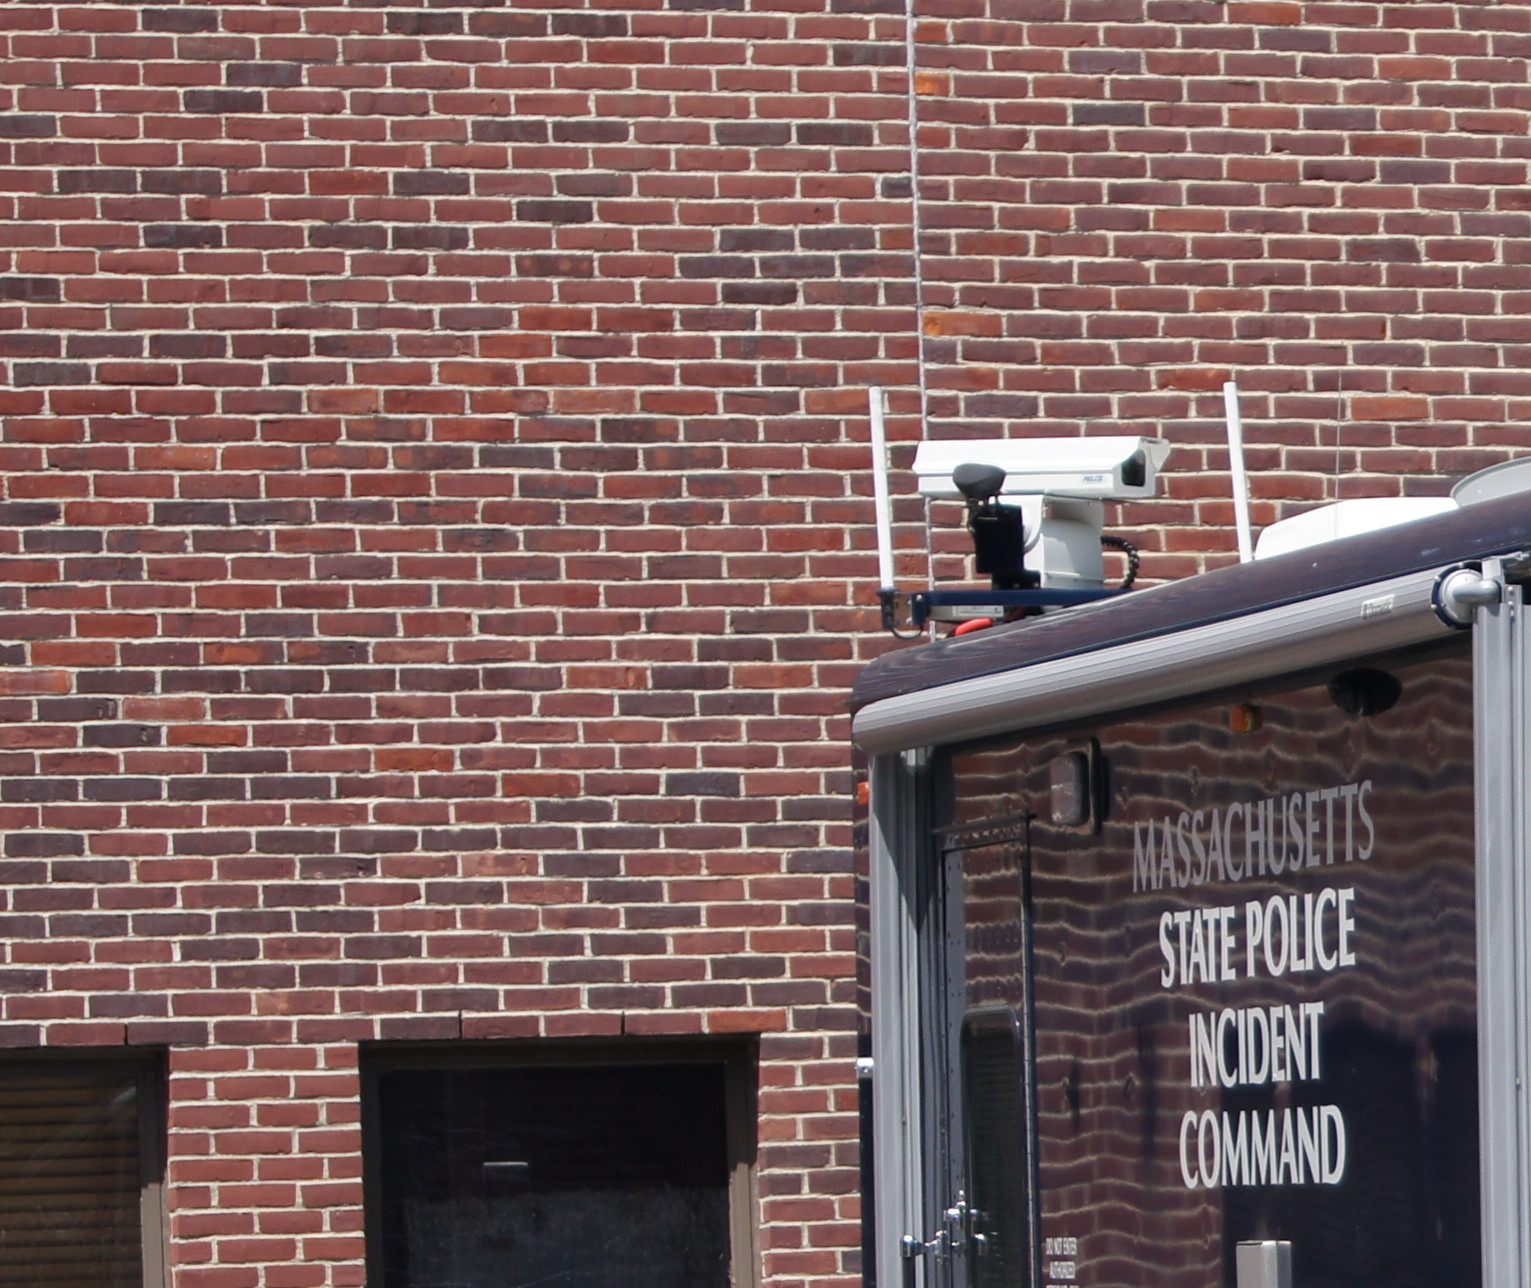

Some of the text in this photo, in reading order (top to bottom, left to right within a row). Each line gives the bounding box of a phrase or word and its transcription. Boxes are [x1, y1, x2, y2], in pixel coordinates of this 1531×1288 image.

[1132, 779, 1375, 893] MASSACHUSETTS
[1158, 887, 1356, 988] STATE POLICE
[1188, 1001, 1325, 1088] INCIDENT
[1179, 1104, 1346, 1189] COMMAND
